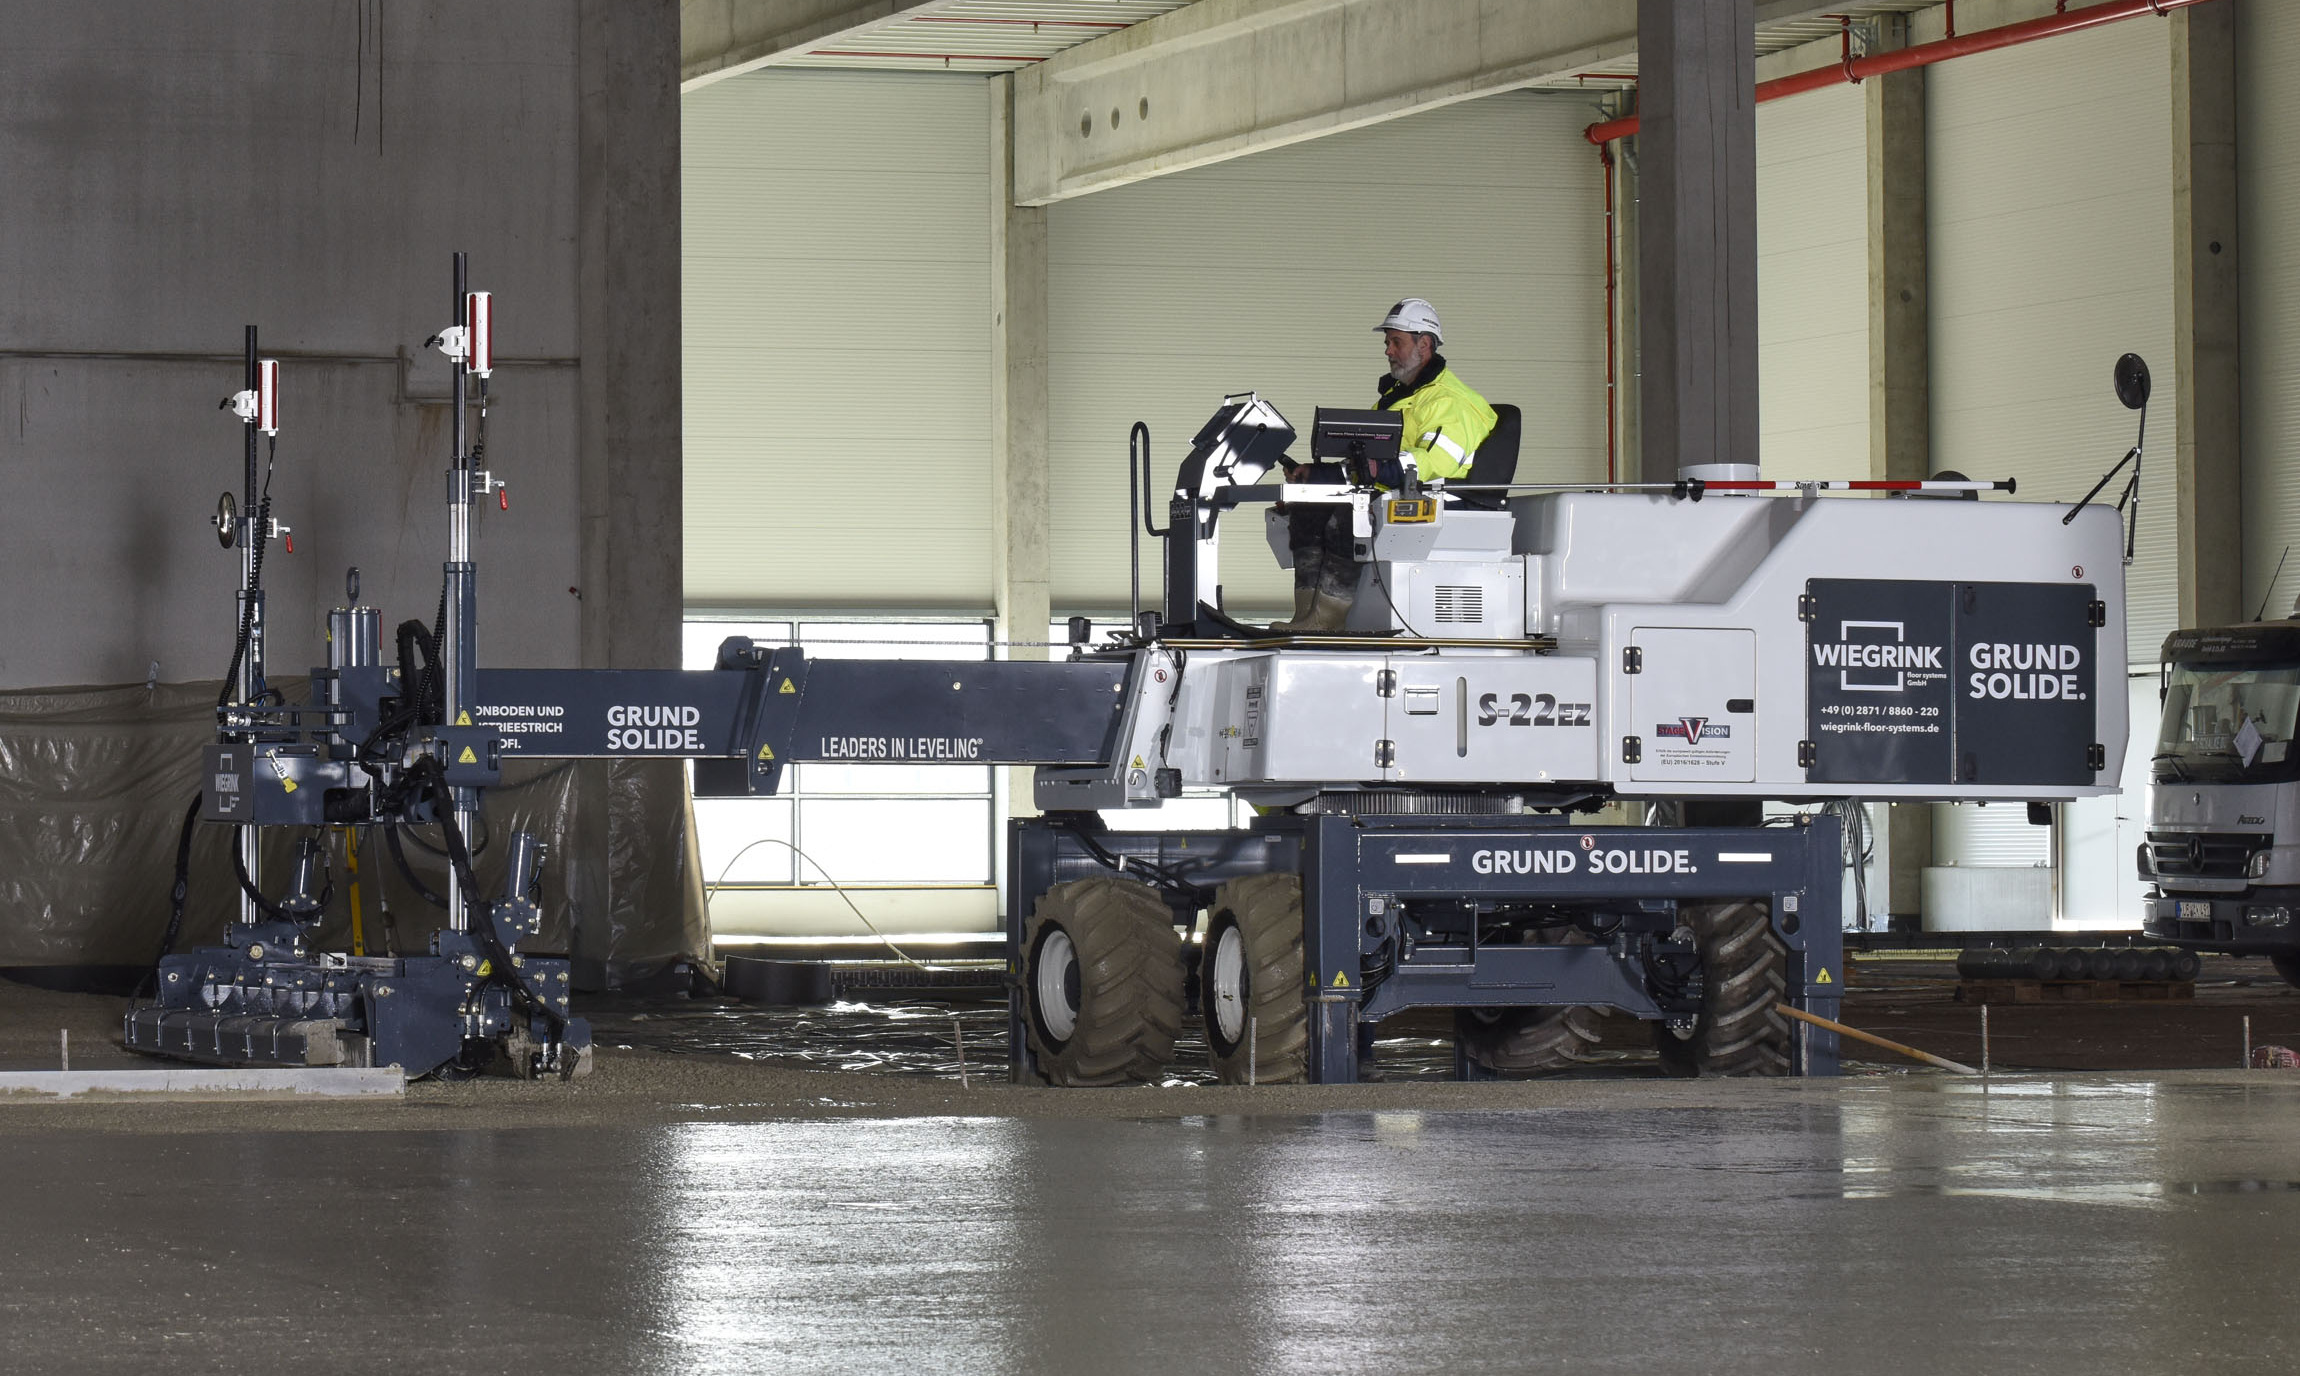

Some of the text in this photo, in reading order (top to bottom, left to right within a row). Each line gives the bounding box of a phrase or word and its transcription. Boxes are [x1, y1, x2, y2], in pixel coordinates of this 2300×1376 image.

[1813, 643, 1943, 669] WIEGRINK
[1969, 642, 2081, 670] GRUND
[1906, 671, 1947, 680] floor systems
[1906, 679, 1927, 687] GmbH
[1969, 672, 2087, 701] SOLIDE.
[537, 706, 565, 717] UND
[607, 705, 701, 726] GRUND
[1820, 705, 1840, 715] +49
[1840, 705, 1855, 717] (0)
[1856, 706, 1880, 716] 2871
[1881, 706, 1887, 716] /
[1888, 706, 1913, 716] 8860
[1920, 707, 1939, 716] 220
[1820, 722, 1940, 734] wiegrink-floor-systems.de
[607, 728, 706, 750] SOLIDE.
[821, 737, 887, 758] LEADERS
[891, 737, 905, 758] IN
[1660, 759, 1673, 767] (EU)
[1472, 850, 1698, 874] GRUND SOLIDE.
